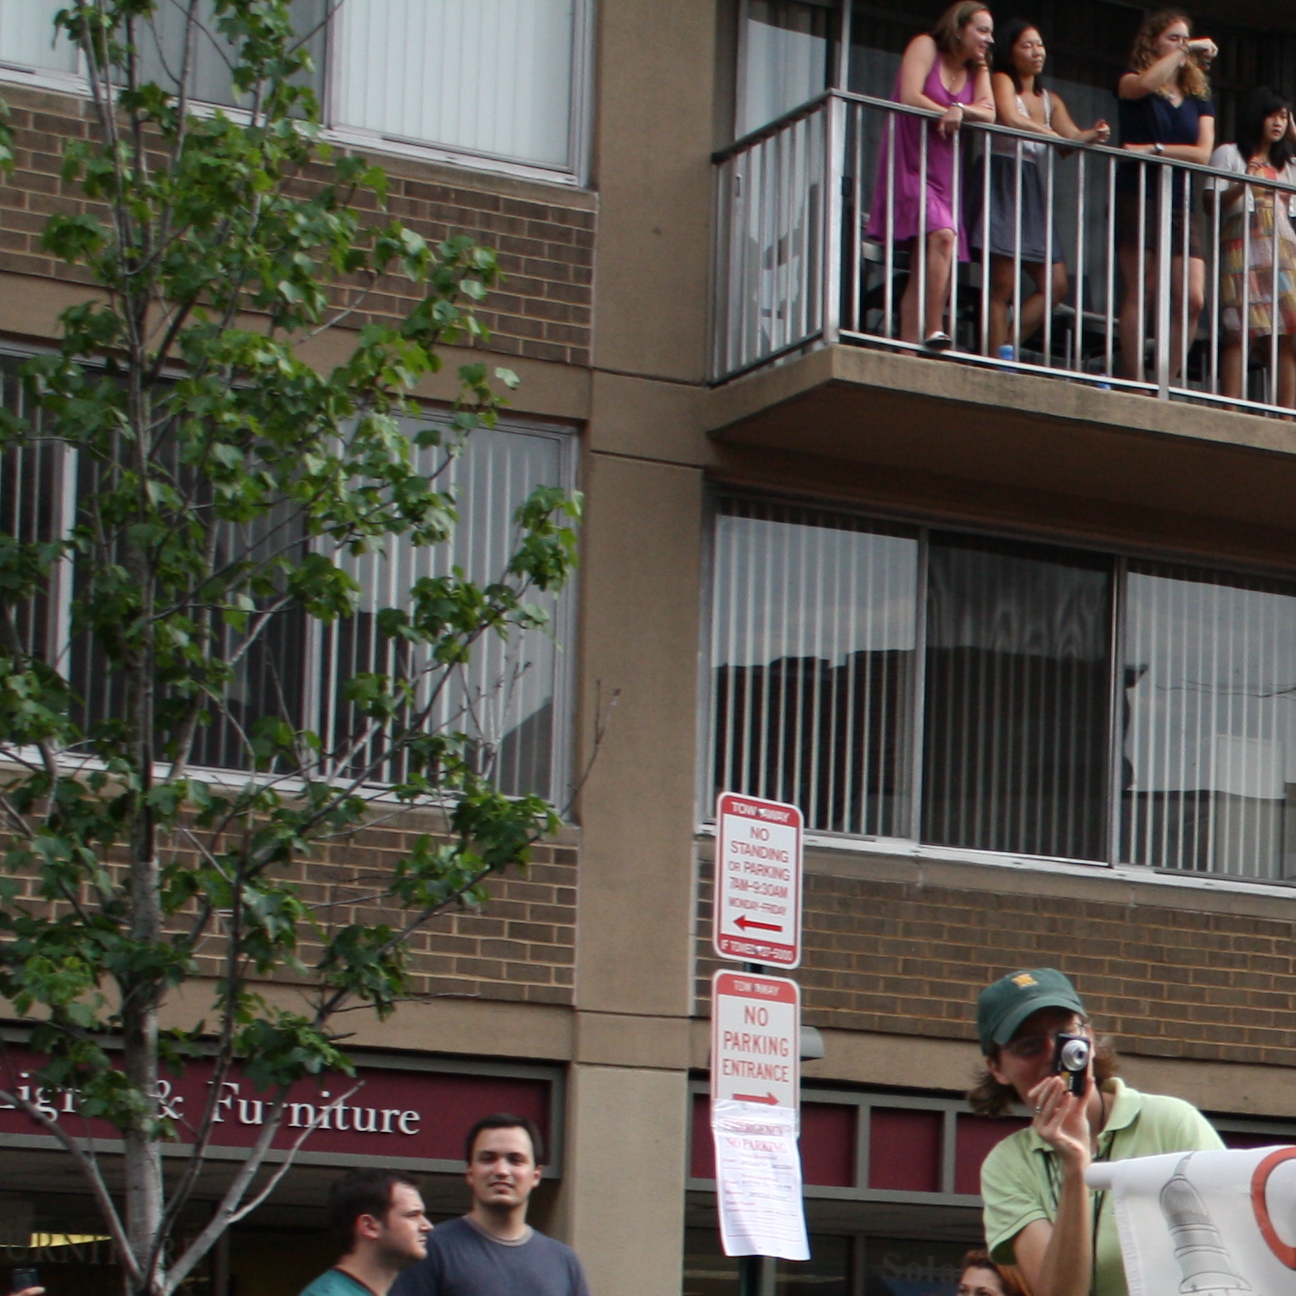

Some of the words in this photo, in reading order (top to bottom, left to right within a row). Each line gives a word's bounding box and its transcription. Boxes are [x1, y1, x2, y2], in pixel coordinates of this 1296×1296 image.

[731, 801, 757, 815] TOW
[750, 826, 769, 841] NO
[730, 841, 789, 863] STANDING
[729, 861, 741, 872] OR
[744, 862, 790, 881] PARKING
[729, 877, 788, 898] 7AM-9:30AM
[721, 941, 729, 951] IF
[733, 980, 751, 992] TOW
[744, 1006, 768, 1026] NO
[724, 1030, 789, 1057] PARKING
[722, 1058, 789, 1083] ENTRANCE
[148, 1079, 183, 1119] &
